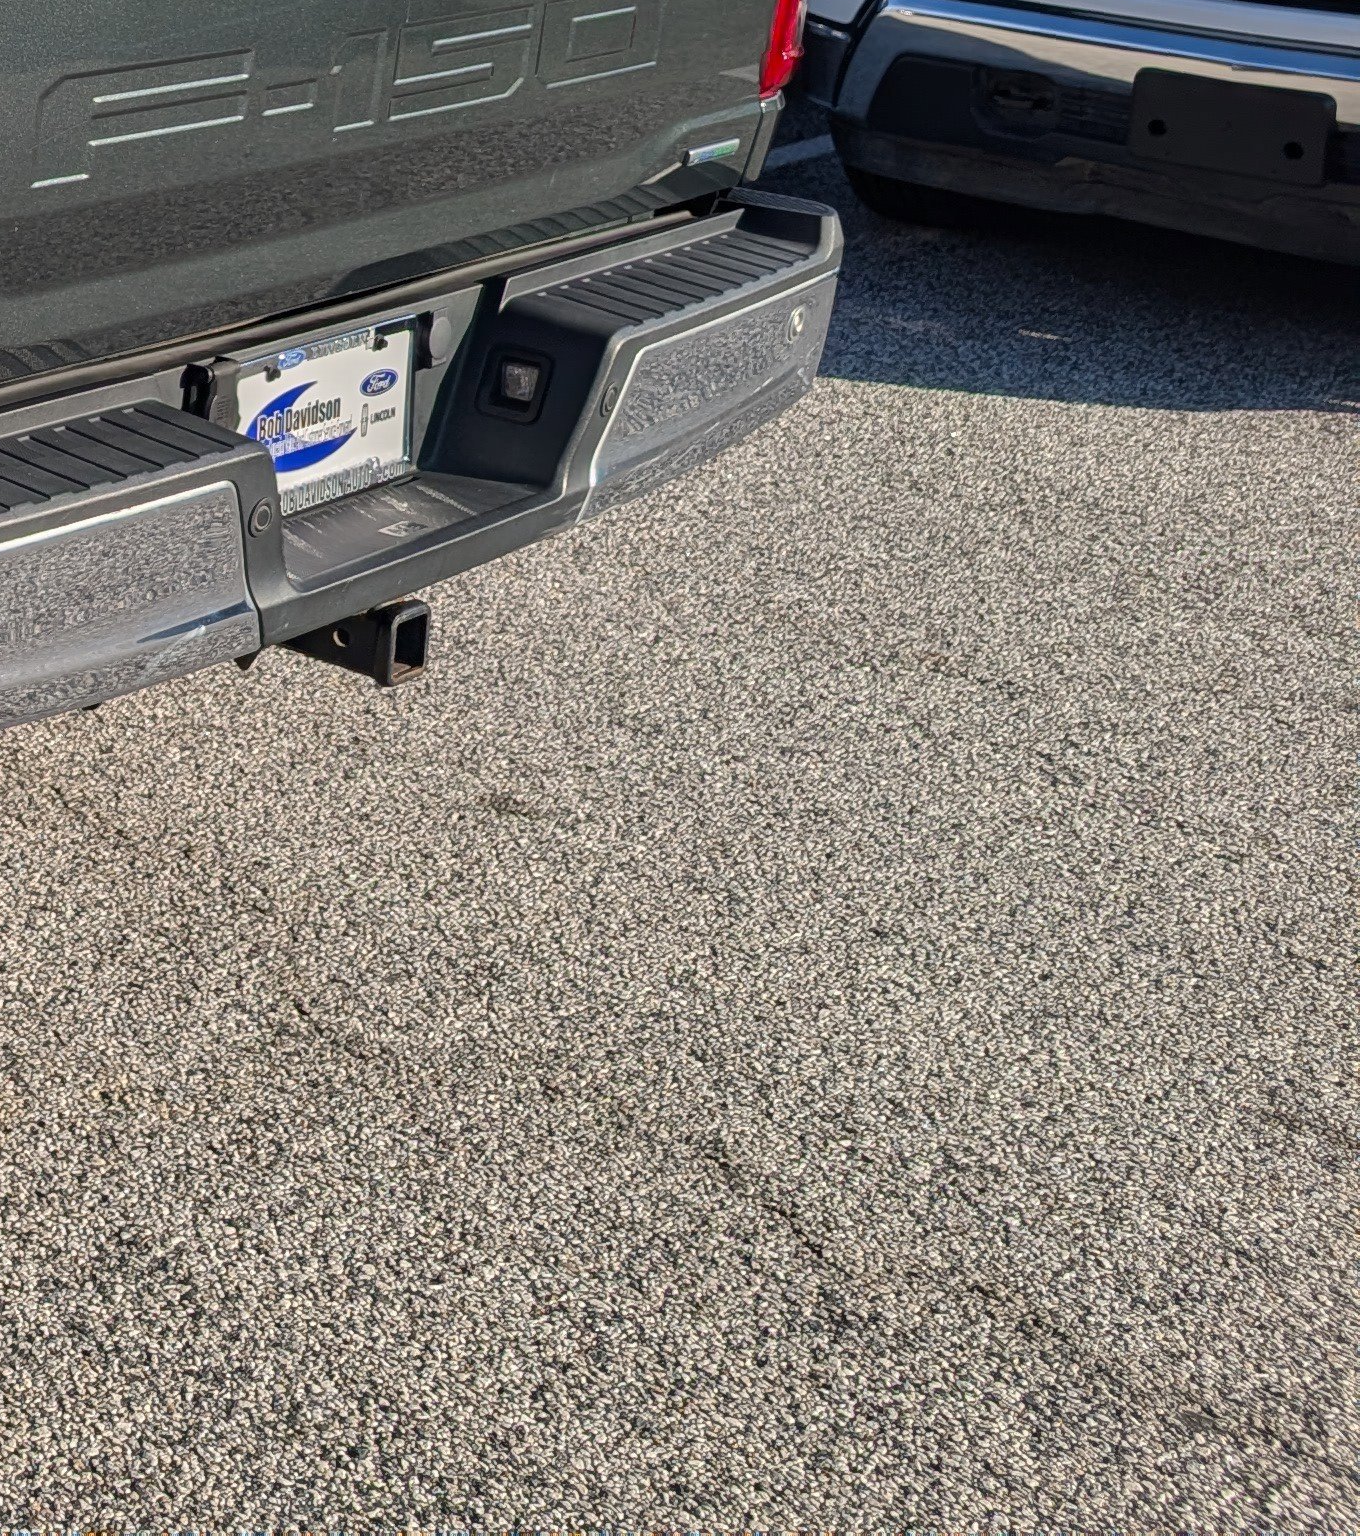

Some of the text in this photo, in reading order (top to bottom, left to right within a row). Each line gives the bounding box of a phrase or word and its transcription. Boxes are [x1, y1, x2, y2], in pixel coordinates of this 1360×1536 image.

[256, 410, 283, 441] Bob
[283, 396, 342, 434] Davidson
[370, 407, 396, 424] LINCOLN
